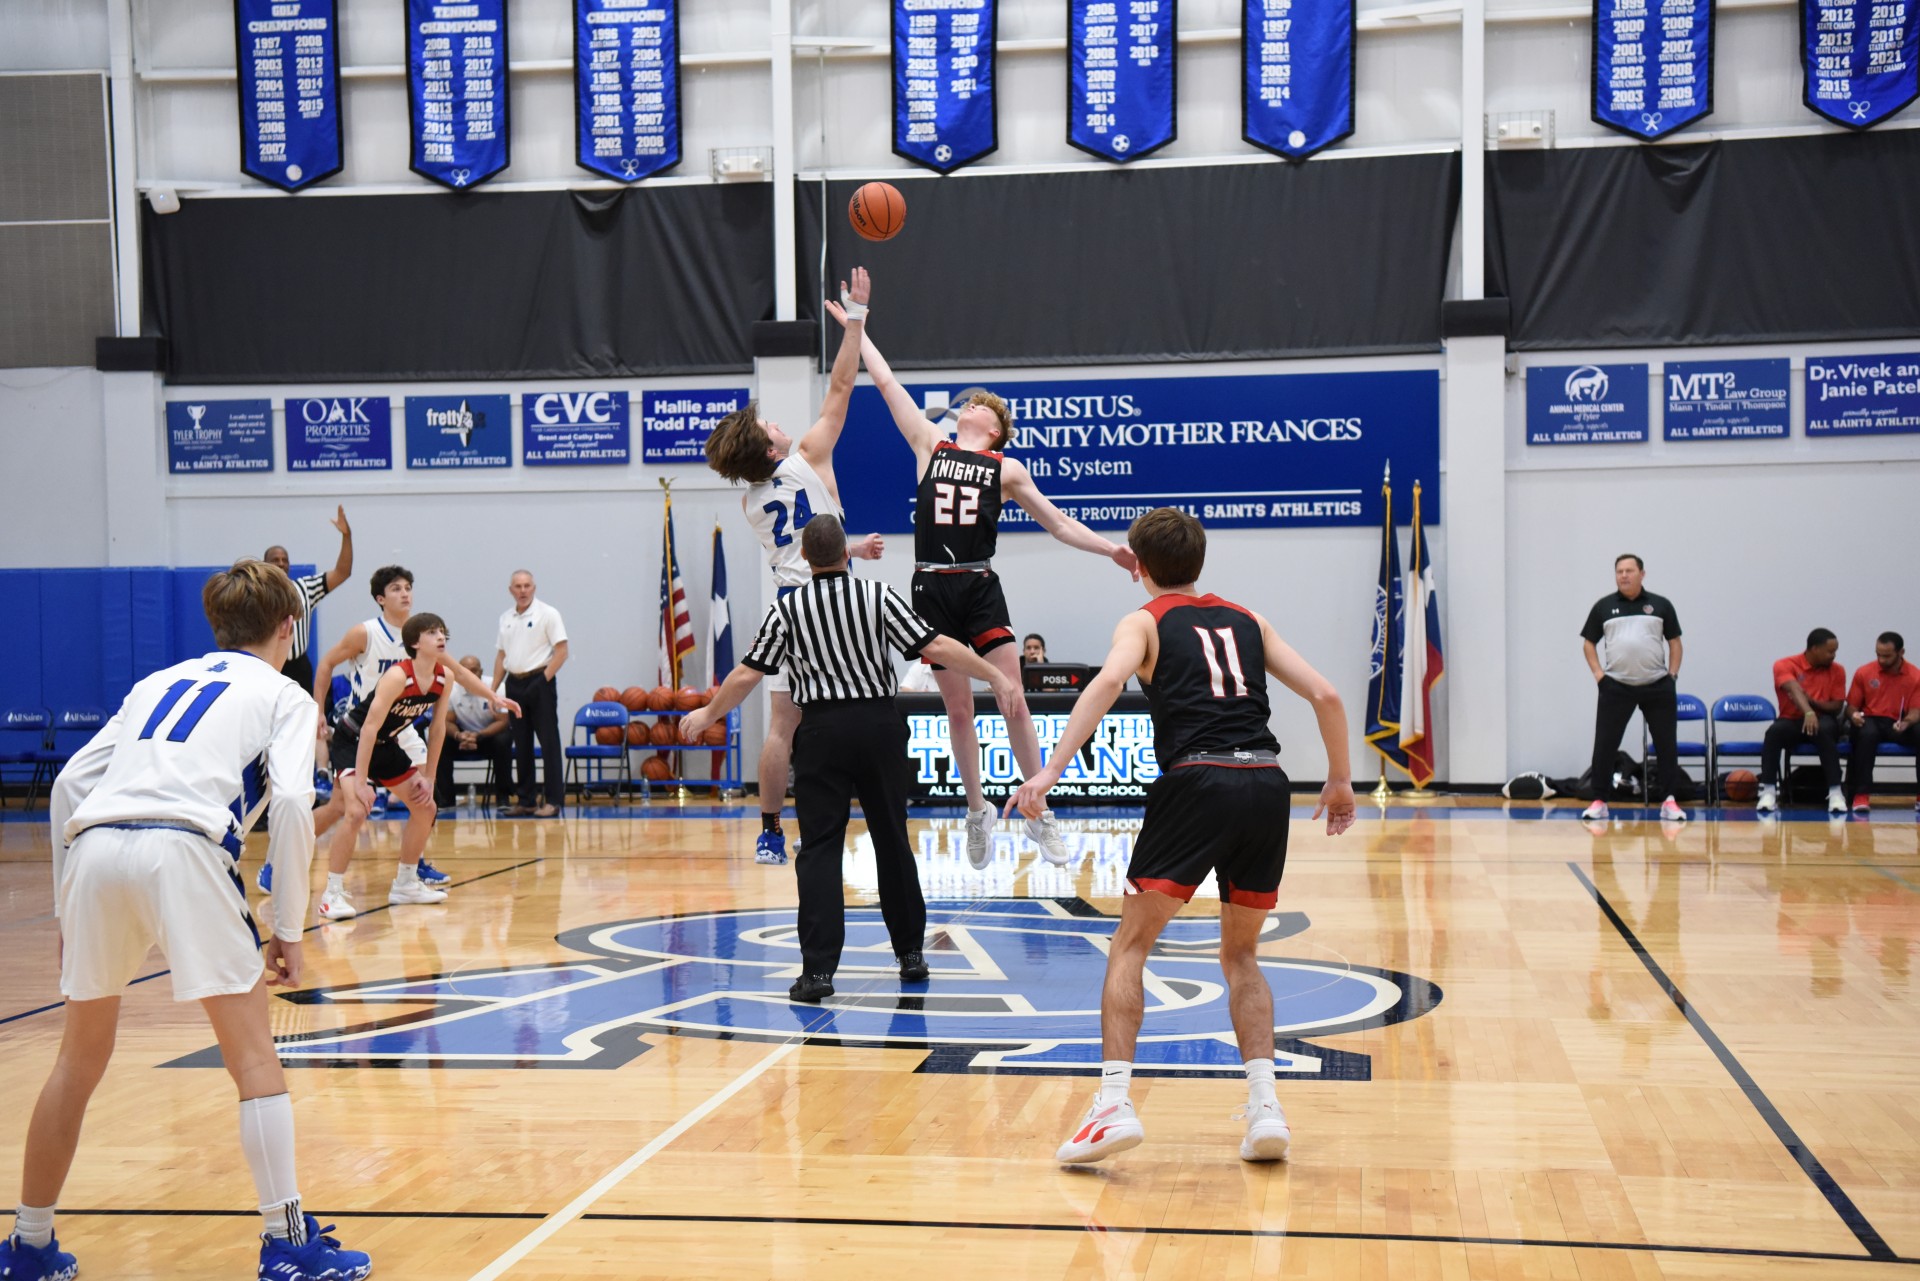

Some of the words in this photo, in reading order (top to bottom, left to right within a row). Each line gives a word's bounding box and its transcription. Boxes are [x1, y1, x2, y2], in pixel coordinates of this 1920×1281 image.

[432, 5, 479, 19] TENNIS
[586, 9, 666, 24] CHAMPIONS
[1821, 8, 1853, 22] 2012
[1872, 4, 1905, 18] 2018
[248, 18, 327, 33] CHAMPIONS
[419, 20, 497, 34] CHAMPIONS
[1129, 23, 1158, 36] 2017
[1262, 19, 1292, 32] 1997
[1613, 19, 1645, 33] 2000
[1662, 16, 1693, 30] 2006
[632, 26, 660, 39] 2003
[1086, 25, 1116, 39] 2007
[1871, 28, 1904, 43] 2019
[254, 36, 280, 50] 1997
[464, 36, 491, 49] 2016
[908, 36, 937, 48] 2002
[1819, 32, 1852, 46] 2013
[1261, 42, 1289, 54] 2001
[1613, 43, 1643, 57] 2001
[1661, 40, 1693, 53] 2007
[592, 50, 618, 63] 1997
[633, 48, 661, 61] 2004
[1870, 50, 1902, 65] 2021
[255, 58, 282, 71] 2003
[296, 56, 323, 69] 2013
[424, 59, 451, 72] 2010
[465, 58, 492, 71] 2017
[907, 58, 937, 71] 2003
[951, 55, 978, 69] 2020
[1818, 56, 1850, 69] 2014
[1261, 65, 1291, 77] 2003
[1612, 66, 1644, 79] 2002
[1661, 62, 1693, 76] 2008
[633, 70, 662, 82] 2005
[256, 79, 283, 92] 2004
[297, 77, 322, 91] 2014
[425, 80, 450, 93] 2011
[465, 79, 492, 92] 2018
[907, 79, 936, 91] 2004
[951, 78, 977, 92] 2021
[1819, 79, 1850, 92] 2015
[1086, 91, 1115, 104] 2013
[1260, 87, 1290, 99] 2014
[1612, 90, 1644, 102] 2003
[1660, 86, 1692, 100] 2009
[257, 101, 284, 113] 2005
[298, 98, 324, 112] 2015
[424, 101, 452, 114] 2013
[466, 101, 493, 113] 2019
[908, 100, 936, 112] 2005
[593, 115, 620, 128] 2001
[634, 113, 663, 126] 2007
[1086, 114, 1116, 126] 2014
[424, 121, 452, 134] 2014
[467, 120, 492, 133] 2021
[259, 143, 286, 155] 2007
[424, 143, 452, 155] 2015
[594, 137, 621, 149] 2002
[1896, 364, 1920, 377] an
[1724, 390, 1747, 400] Law
[1749, 388, 1787, 400] Group
[1820, 381, 1868, 402] Janie
[302, 398, 371, 424] OAK
[534, 392, 610, 424] CVC
[654, 400, 702, 414] Hallie
[706, 399, 737, 413] and
[1550, 405, 1573, 413] ANIMAL
[1574, 404, 1600, 413] MEDICAL
[1601, 403, 1624, 412] CENTER
[1669, 402, 1693, 412] Mann
[1704, 402, 1732, 411] Tindel
[1742, 401, 1786, 410] Thompson
[644, 417, 685, 431] Todd
[1809, 420, 1830, 429] ALL
[1832, 418, 1873, 428] SAINTS
[1875, 416, 1920, 427] ATHLETI
[173, 430, 194, 441] TYLER
[196, 429, 223, 440] TROPHY
[305, 424, 371, 437] PROPERTIES
[1003, 425, 1095, 448] RINITY
[1103, 422, 1225, 447] MOTHER
[1230, 417, 1362, 444] FRANCES
[1533, 433, 1551, 442] ALL
[1553, 432, 1589, 441] SAINTS
[1591, 431, 1642, 440] ATHLETICS
[1670, 428, 1689, 437] ALL
[1691, 427, 1728, 436] SAINTS
[1731, 425, 1783, 435] ATHLETICS
[526, 450, 543, 459] ALL
[545, 450, 578, 459] SAINTS
[580, 449, 626, 458] ATHLETICS
[646, 448, 663, 457] ALL
[665, 447, 697, 456] SAINTS
[175, 461, 191, 470] ALL
[193, 460, 223, 469] SAINTS
[226, 459, 268, 468] ATHLETICS
[292, 460, 308, 468] ALL
[310, 459, 341, 468] SAINTS
[343, 458, 386, 467] ATHLETICS
[412, 458, 428, 466] ALL
[430, 457, 460, 466] SAINTS
[462, 456, 506, 465] ATHLETICS
[931, 459, 995, 487] KNIGHTS
[1058, 457, 1132, 481] System
[934, 482, 981, 526] 22
[1204, 503, 1266, 518] SAINTS
[1270, 501, 1361, 517] ATHLETICS
[763, 488, 817, 548] 24
[1192, 625, 1248, 697] 11
[138, 679, 231, 743] 11
[1729, 703, 1738, 711] All
[1740, 703, 1763, 711] Saints
[929, 786, 954, 795] ALL
[956, 785, 1006, 796] SNTS
[1088, 785, 1148, 796] SCHOOL
